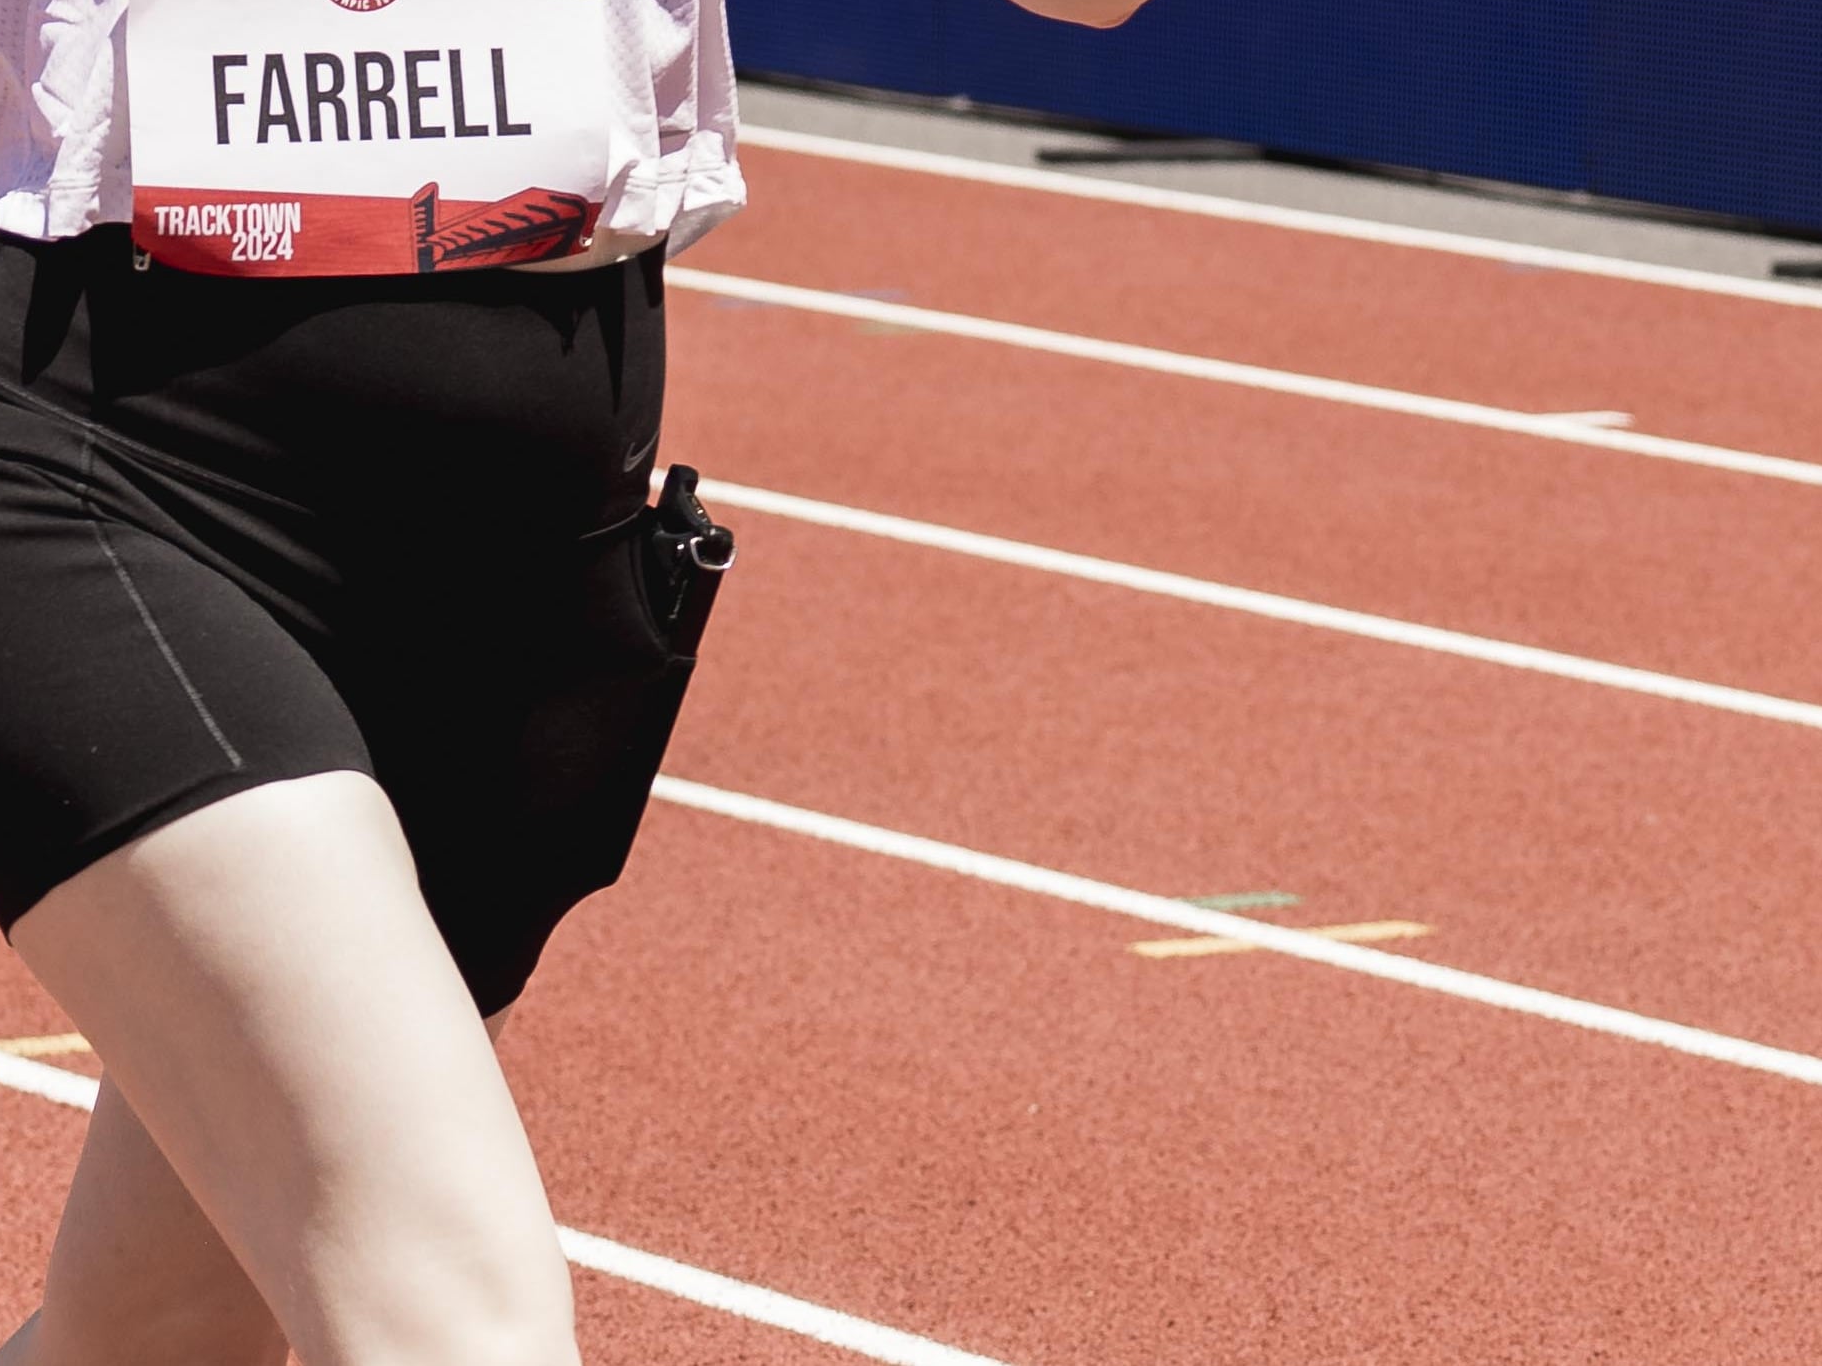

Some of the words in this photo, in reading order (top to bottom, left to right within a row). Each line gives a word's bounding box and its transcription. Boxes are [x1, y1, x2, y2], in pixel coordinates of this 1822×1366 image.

[211, 47, 533, 146] FARRELL
[153, 201, 301, 236] TRACKTOWN
[231, 231, 294, 261] 2024
